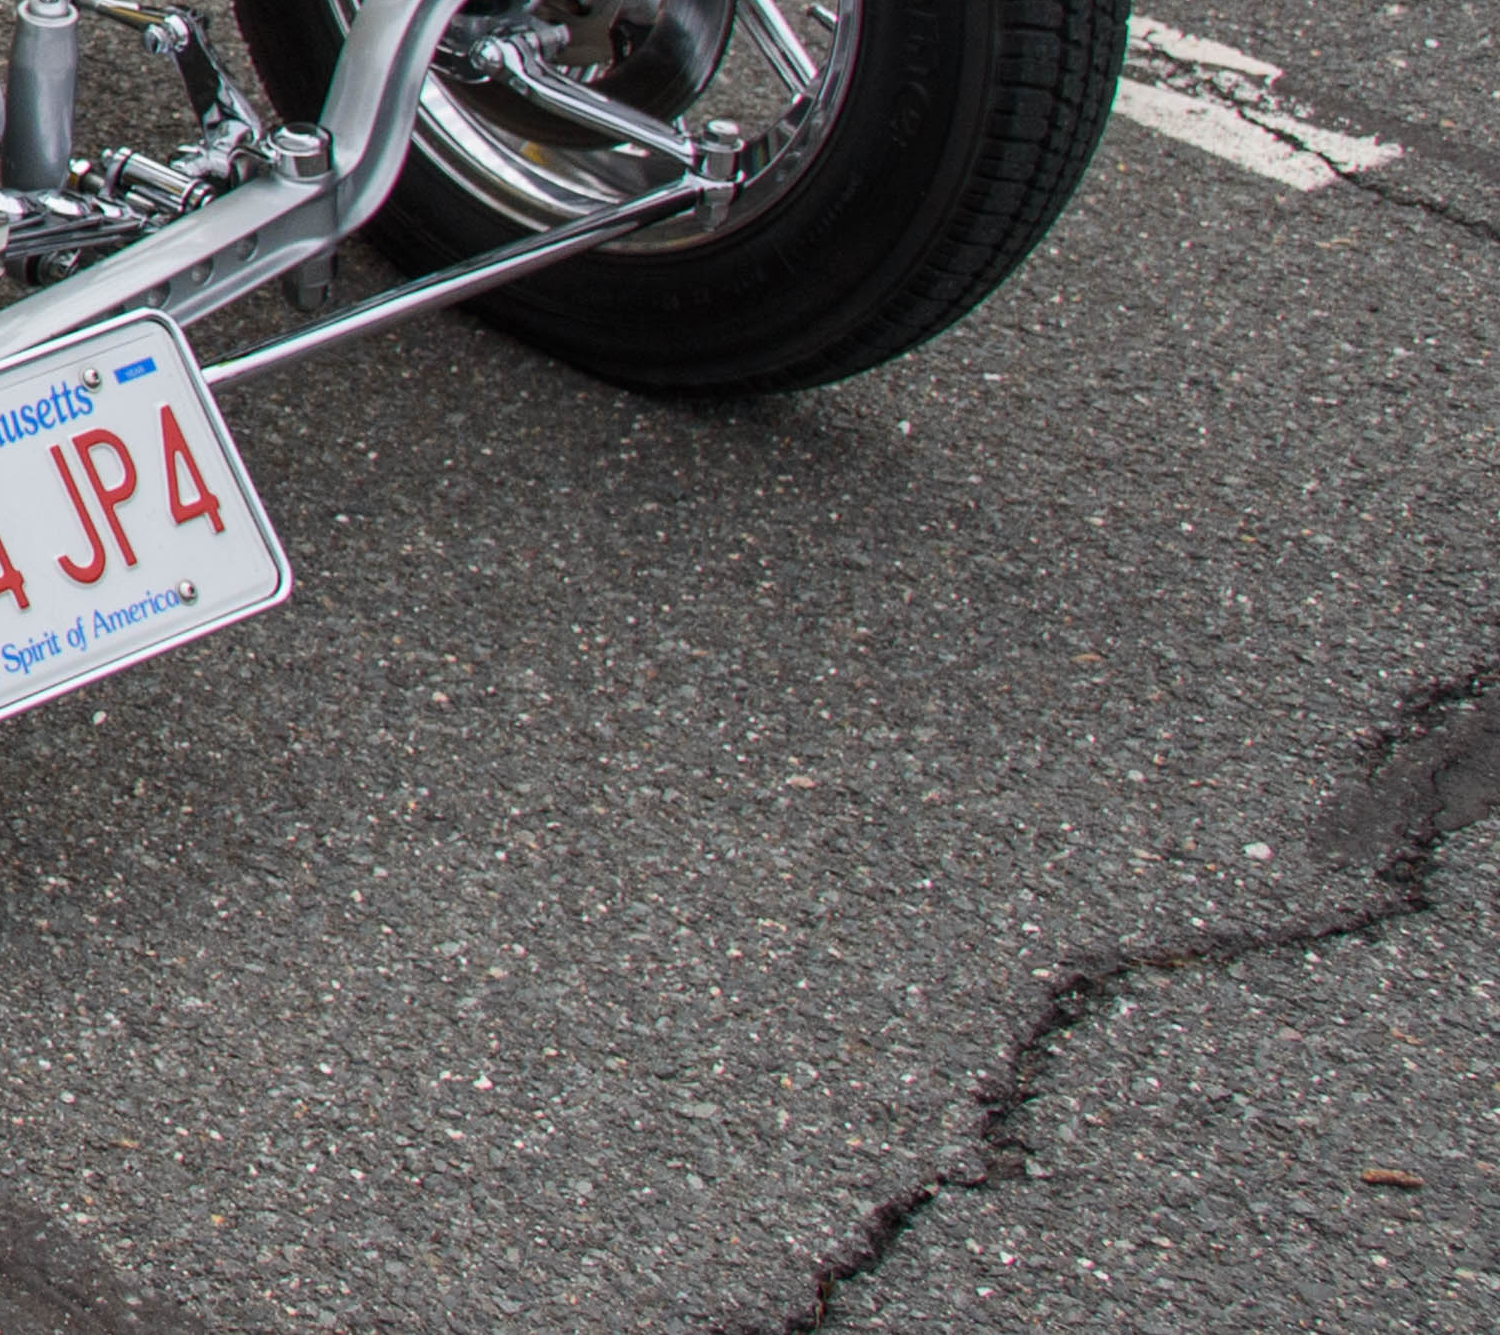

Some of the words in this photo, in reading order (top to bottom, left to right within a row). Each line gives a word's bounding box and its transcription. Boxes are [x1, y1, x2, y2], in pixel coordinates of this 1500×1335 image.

[3, 629, 62, 687] Spirit
[67, 616, 89, 652] of
[93, 585, 181, 637] America
